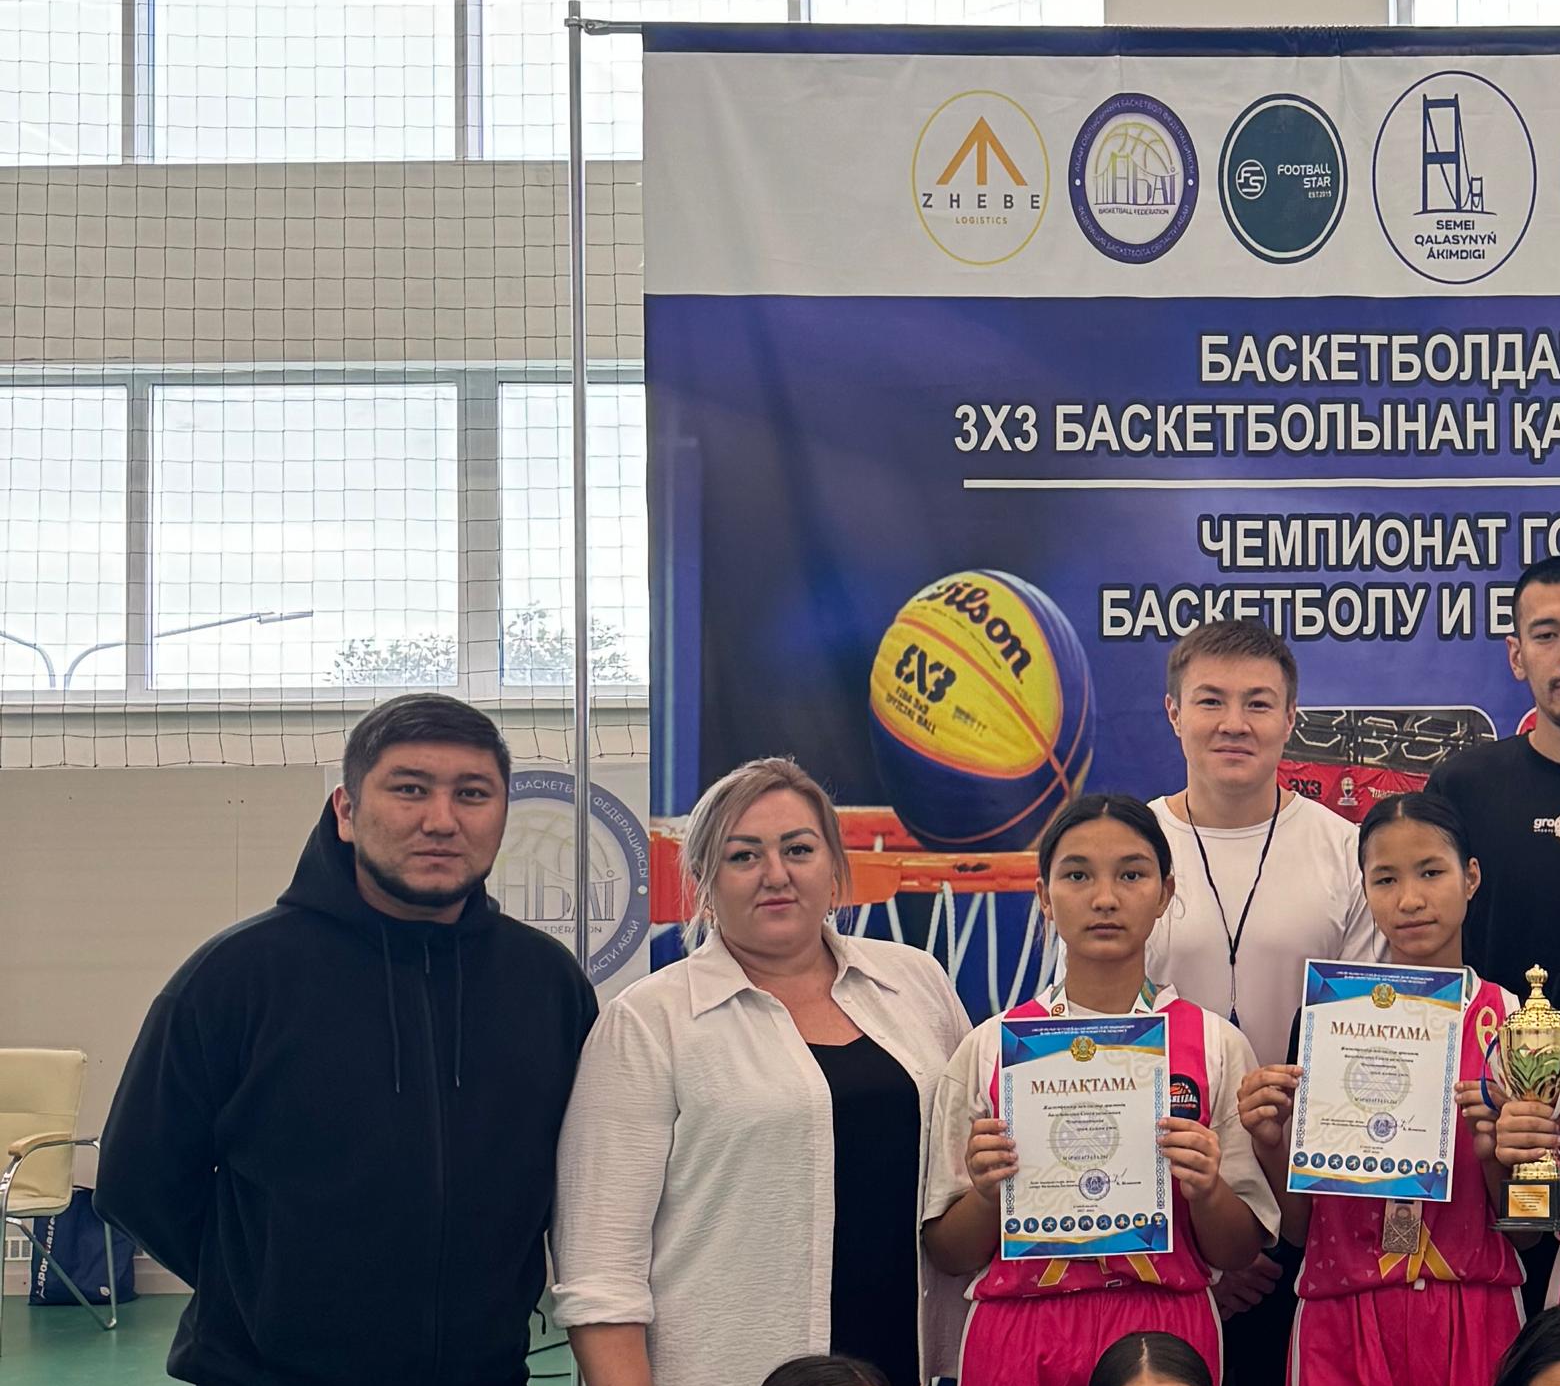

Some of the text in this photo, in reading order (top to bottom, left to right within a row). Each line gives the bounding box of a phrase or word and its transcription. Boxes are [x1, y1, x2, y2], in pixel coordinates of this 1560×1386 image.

[1277, 163, 1332, 175] FOOTBALL
[1303, 177, 1331, 189] STAR
[921, 193, 1042, 210] ZHEBE
[955, 216, 1009, 225] LOGISTICS
[1436, 219, 1475, 231] SEMEI
[1055, 401, 1496, 453] БАСКЕТБОЛЫНАН
[1200, 517, 1506, 568] ЧЕМПИОНАТ
[1442, 588, 1473, 636] И
[593, 796, 649, 879] ФЕДЕРАЦИЯСЫ
[1330, 1021, 1432, 1042] МАДАҚТАМА
[1031, 1076, 1137, 1097] МАДАҚТАМА
